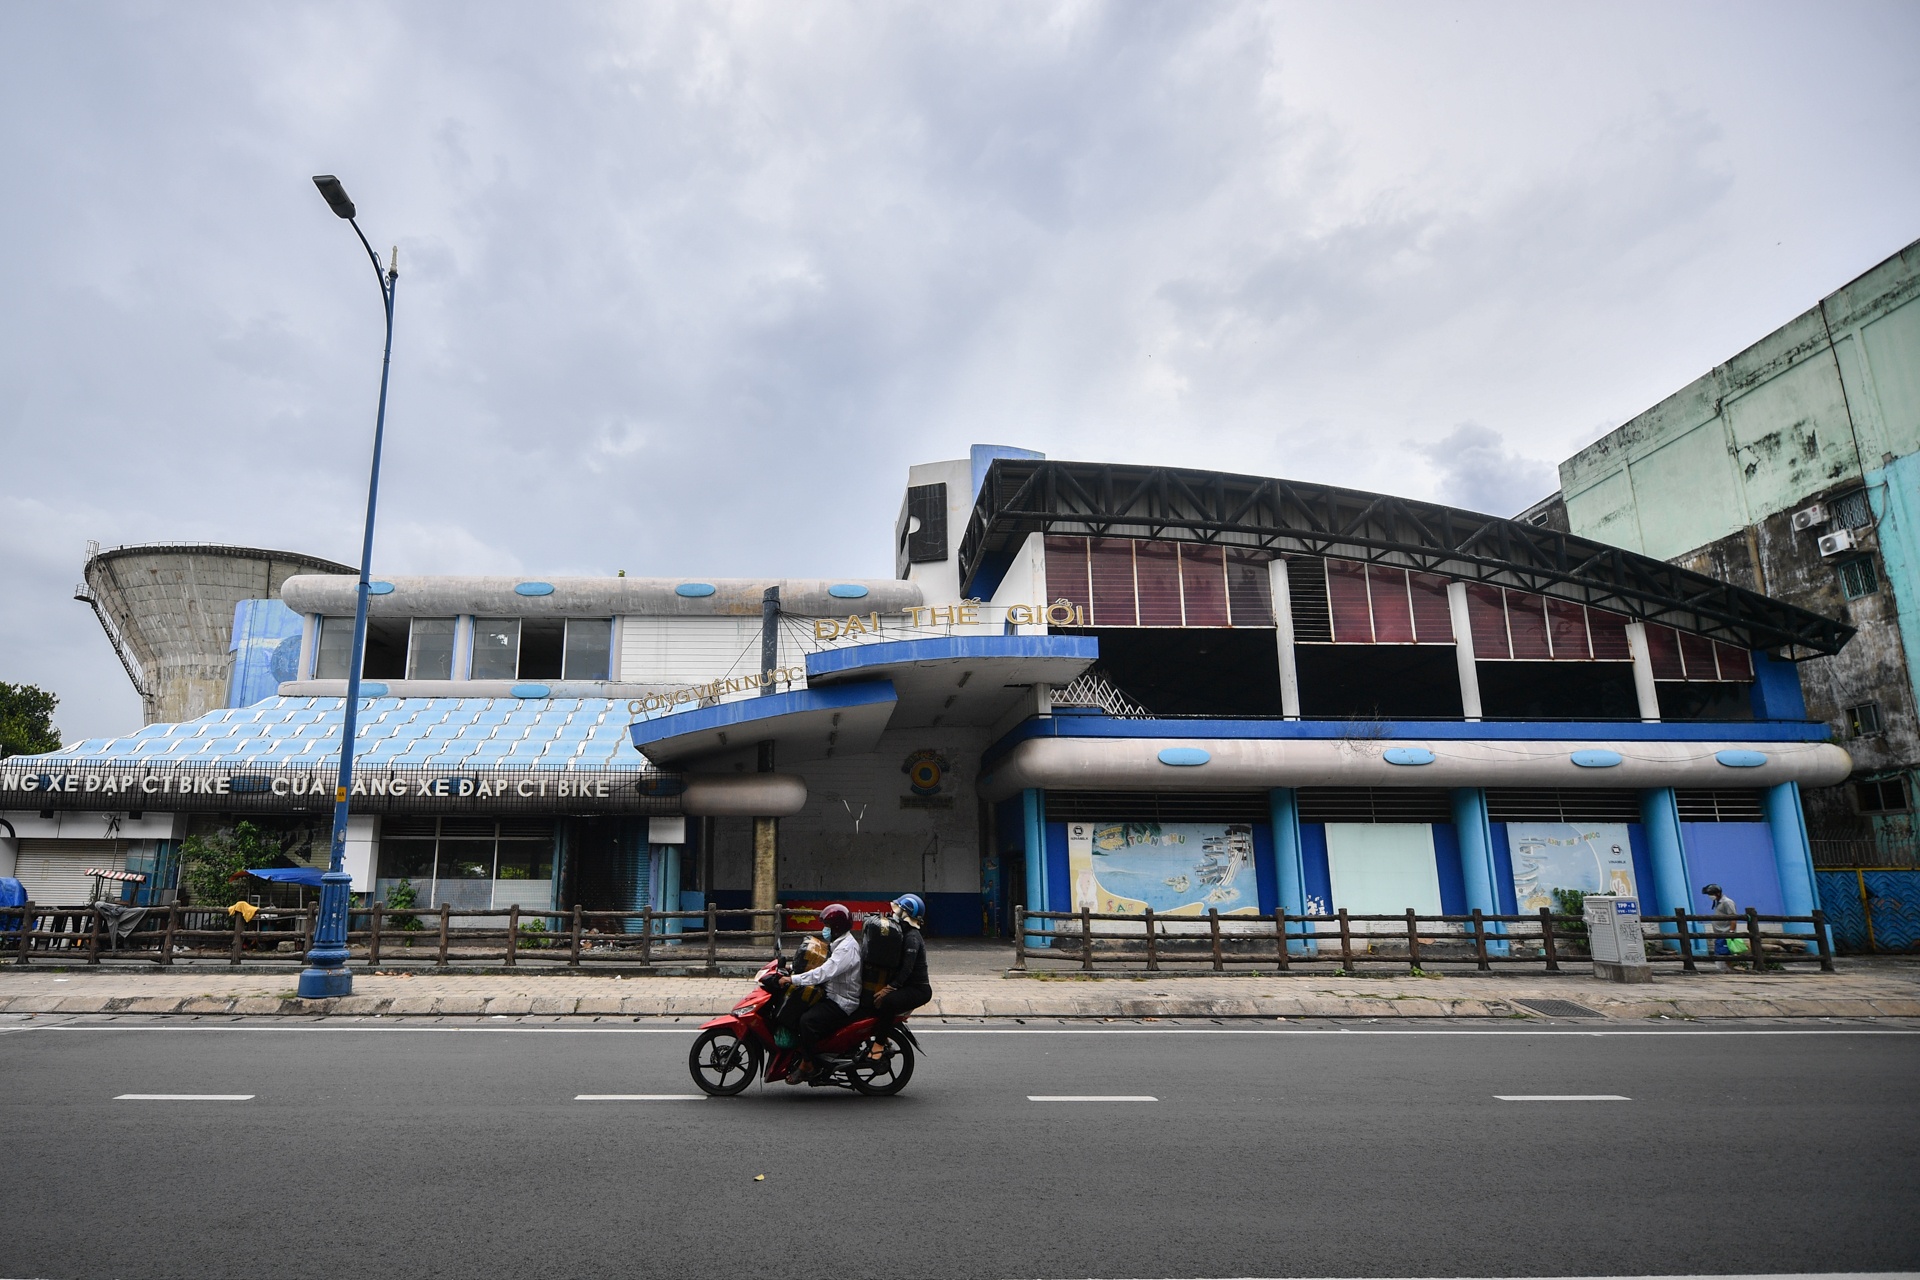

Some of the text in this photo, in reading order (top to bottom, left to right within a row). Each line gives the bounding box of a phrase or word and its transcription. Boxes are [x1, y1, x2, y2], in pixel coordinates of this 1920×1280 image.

[815, 597, 1085, 639] ĐẠI THẾ GIỚI
[627, 689, 691, 715] CÔNG
[692, 678, 740, 700] VIÊN
[47, 775, 79, 792] XE
[86, 776, 134, 796] ĐẠP
[142, 776, 171, 793] CT
[180, 777, 231, 795] BIKE
[271, 771, 326, 796] CỬA
[417, 779, 449, 797] XE
[458, 779, 508, 800] ĐẠP
[517, 779, 548, 798] CT
[557, 780, 610, 798] BIKE
